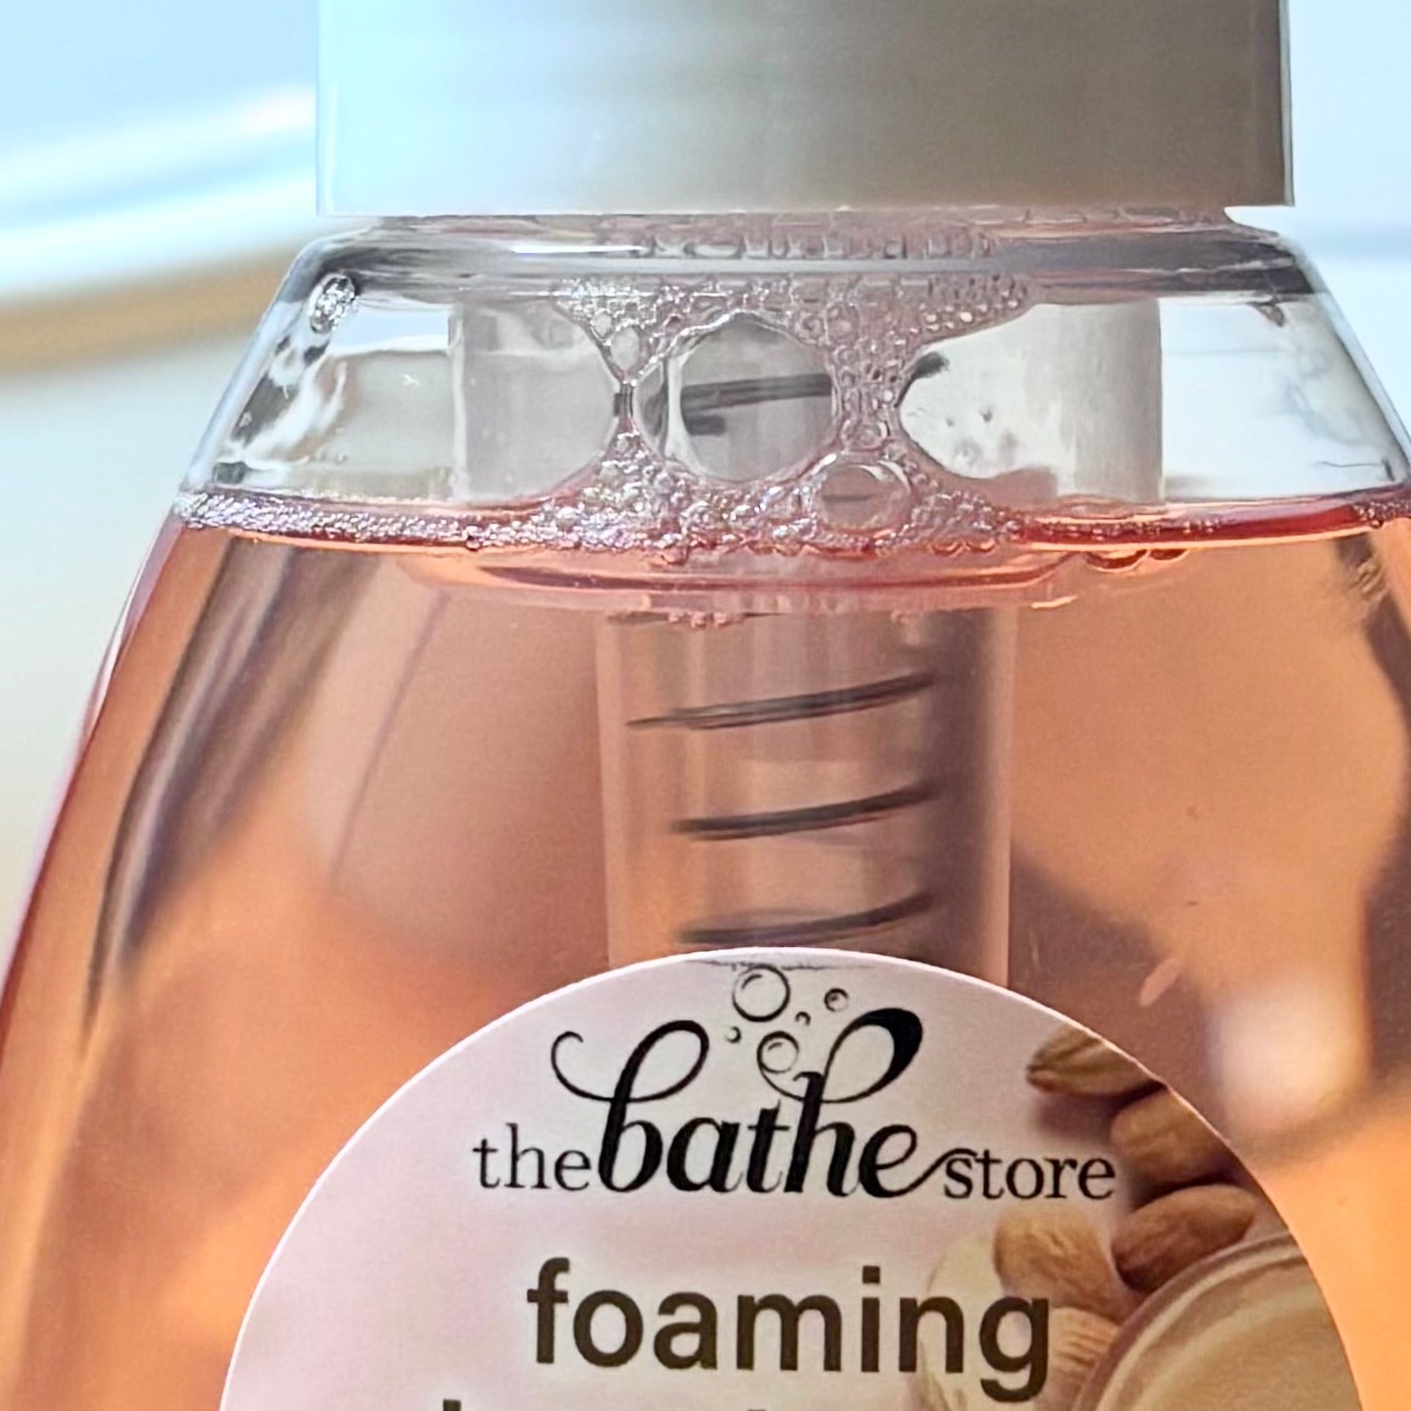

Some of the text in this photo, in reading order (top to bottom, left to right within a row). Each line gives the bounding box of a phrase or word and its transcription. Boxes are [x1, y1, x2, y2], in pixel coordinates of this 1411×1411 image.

[472, 1007, 1117, 1200] the bathe store
[526, 1256, 1051, 1404] foaming
